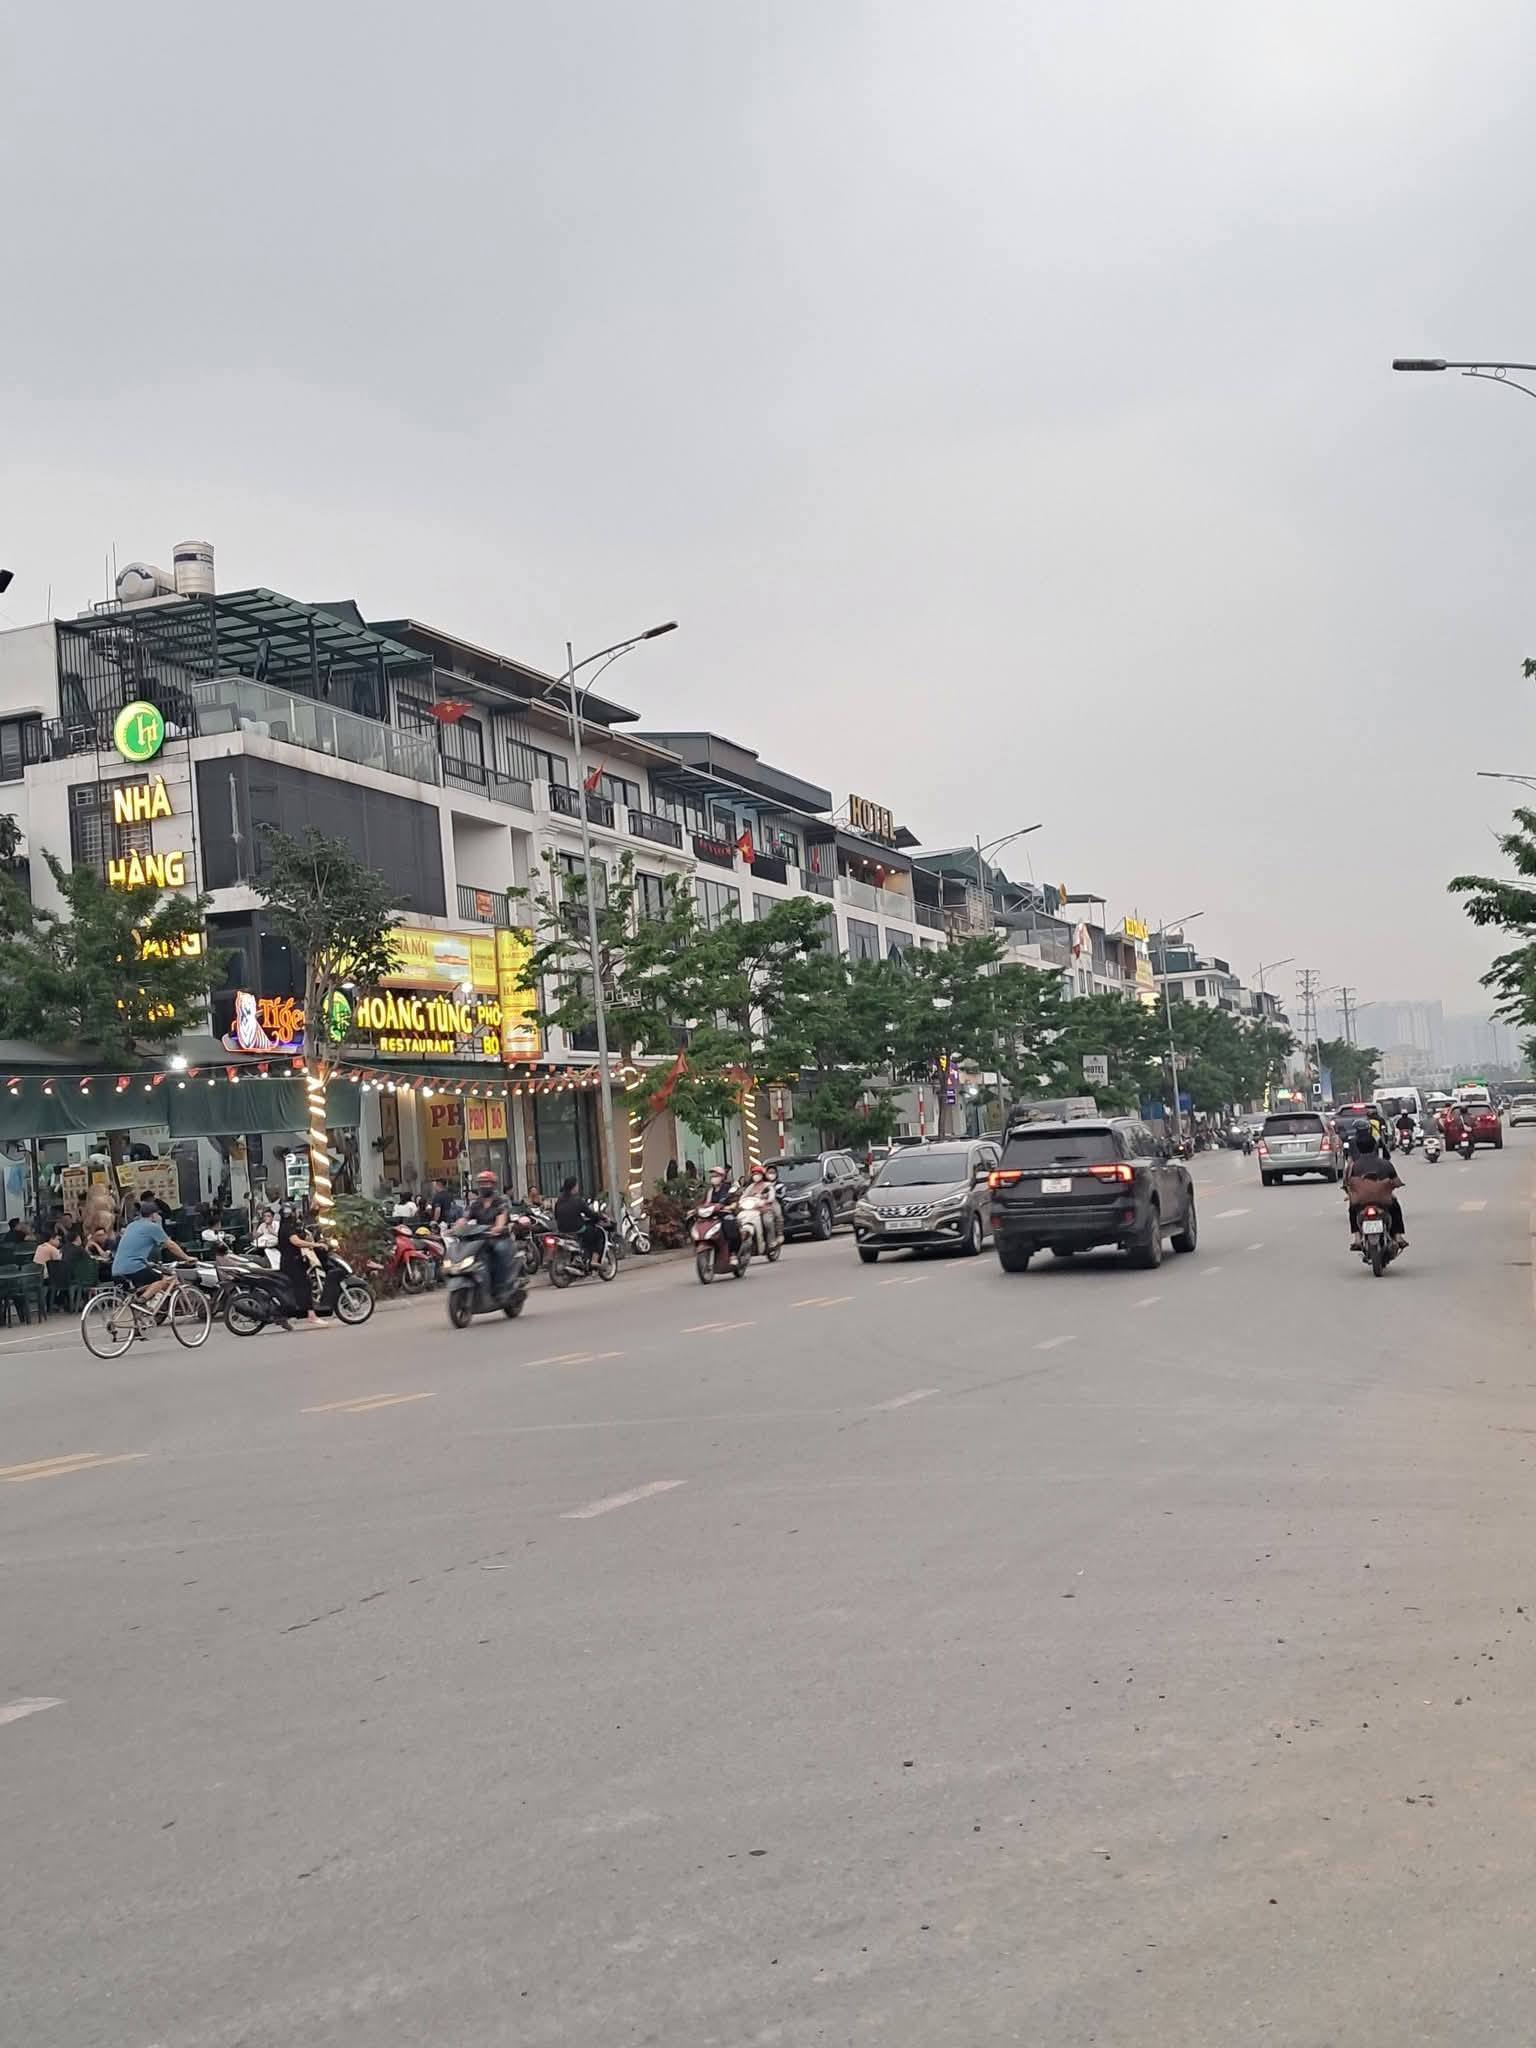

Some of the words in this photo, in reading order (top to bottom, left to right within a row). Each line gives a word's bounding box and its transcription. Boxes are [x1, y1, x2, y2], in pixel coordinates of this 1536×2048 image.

[113, 774, 172, 824] NHÀ
[850, 794, 896, 842] HOTEL
[108, 848, 185, 888] HÀNG
[356, 990, 425, 1031] HOÀNG
[426, 994, 473, 1033] TÙNG
[379, 1037, 455, 1053] RESTAURANT
[483, 1031, 500, 1056] BÒ
